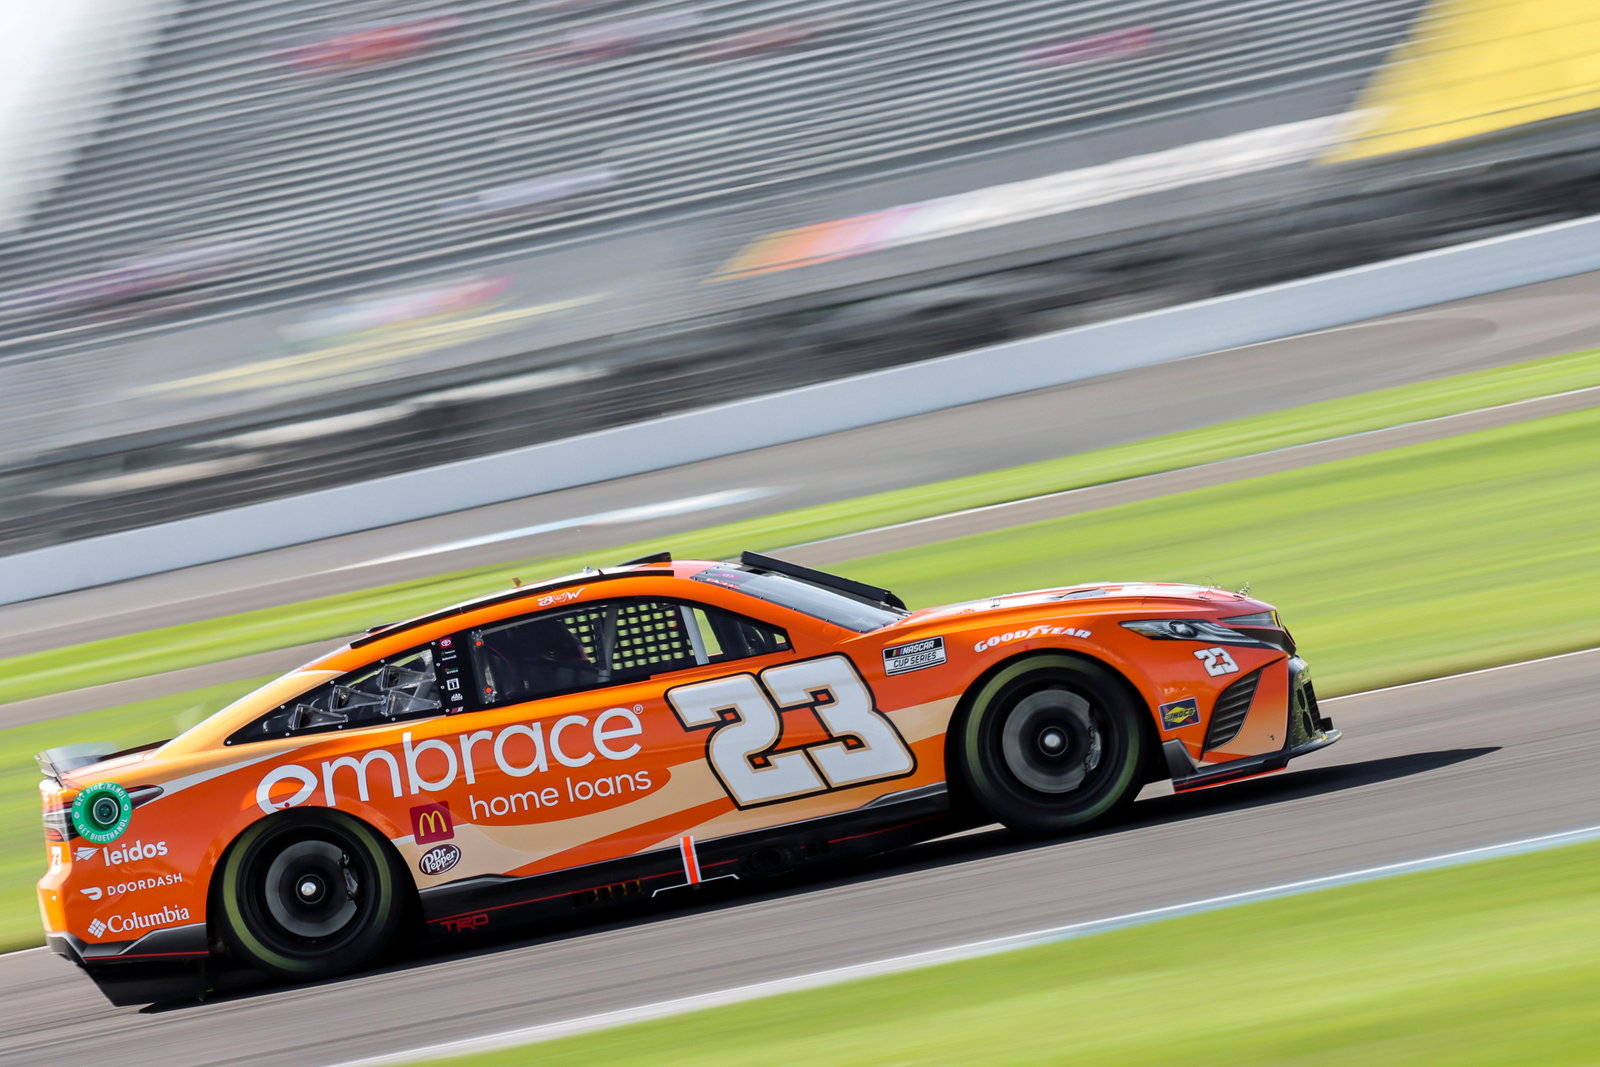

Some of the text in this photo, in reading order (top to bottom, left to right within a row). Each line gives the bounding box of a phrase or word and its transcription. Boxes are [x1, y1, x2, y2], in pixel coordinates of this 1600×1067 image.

[902, 639, 935, 655] NASCAR
[973, 624, 1092, 653] GOODYEAR
[893, 651, 937, 668] CUP SERIES
[1191, 646, 1241, 678] 23
[664, 653, 916, 809] 23
[74, 792, 86, 806] GET
[468, 767, 652, 820] home loans
[78, 818, 128, 842] GET BIOETHANOL
[103, 840, 169, 867] leidos
[422, 850, 456, 873] Pepper
[432, 848, 447, 861] Dr
[107, 873, 183, 896] DOORDASH
[107, 904, 191, 933] Columbia
[440, 914, 489, 933] TRD
